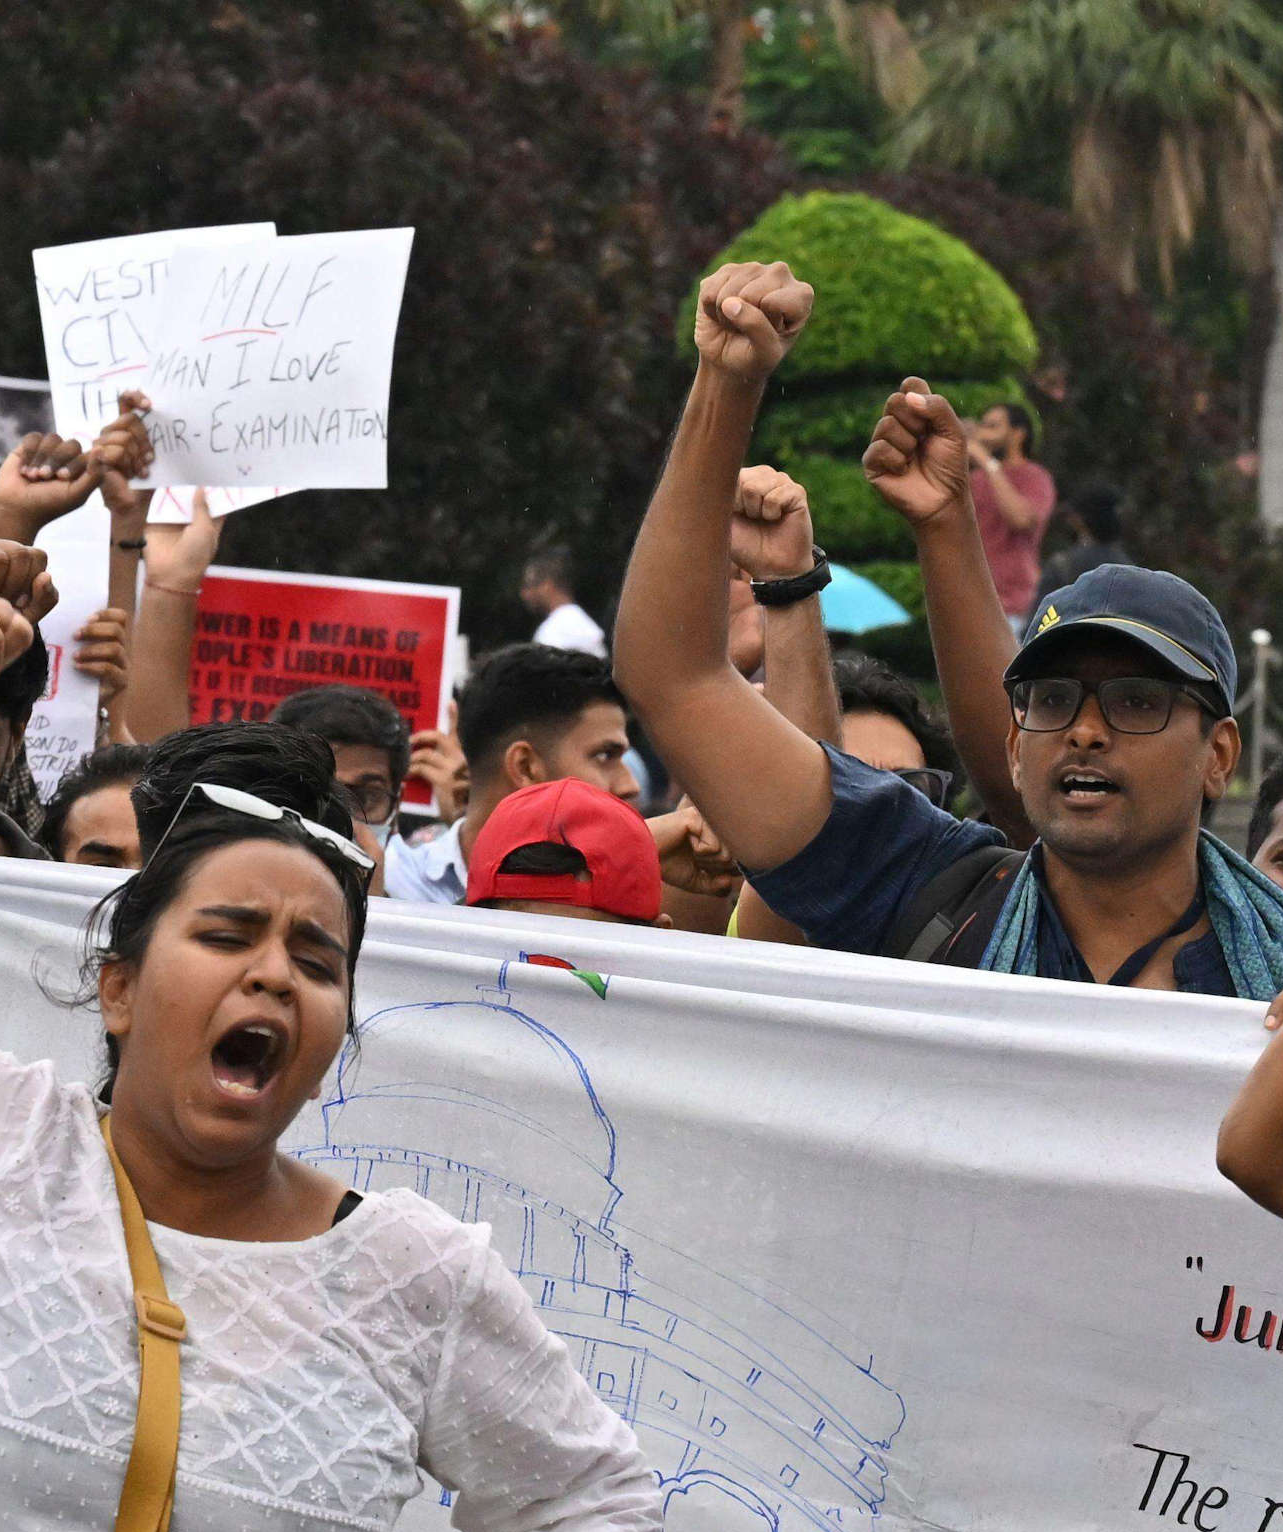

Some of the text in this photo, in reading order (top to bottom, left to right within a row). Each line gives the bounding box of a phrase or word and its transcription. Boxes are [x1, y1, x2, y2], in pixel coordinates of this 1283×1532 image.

[200, 255, 338, 329] MILF
[150, 338, 353, 391] MAN I LOVE
[198, 611, 251, 638] WER
[259, 616, 281, 640] IS
[289, 619, 301, 641] A
[309, 621, 387, 651] MEANS
[29, 754, 77, 771] STRIK
[1133, 1443, 1229, 1532] The
